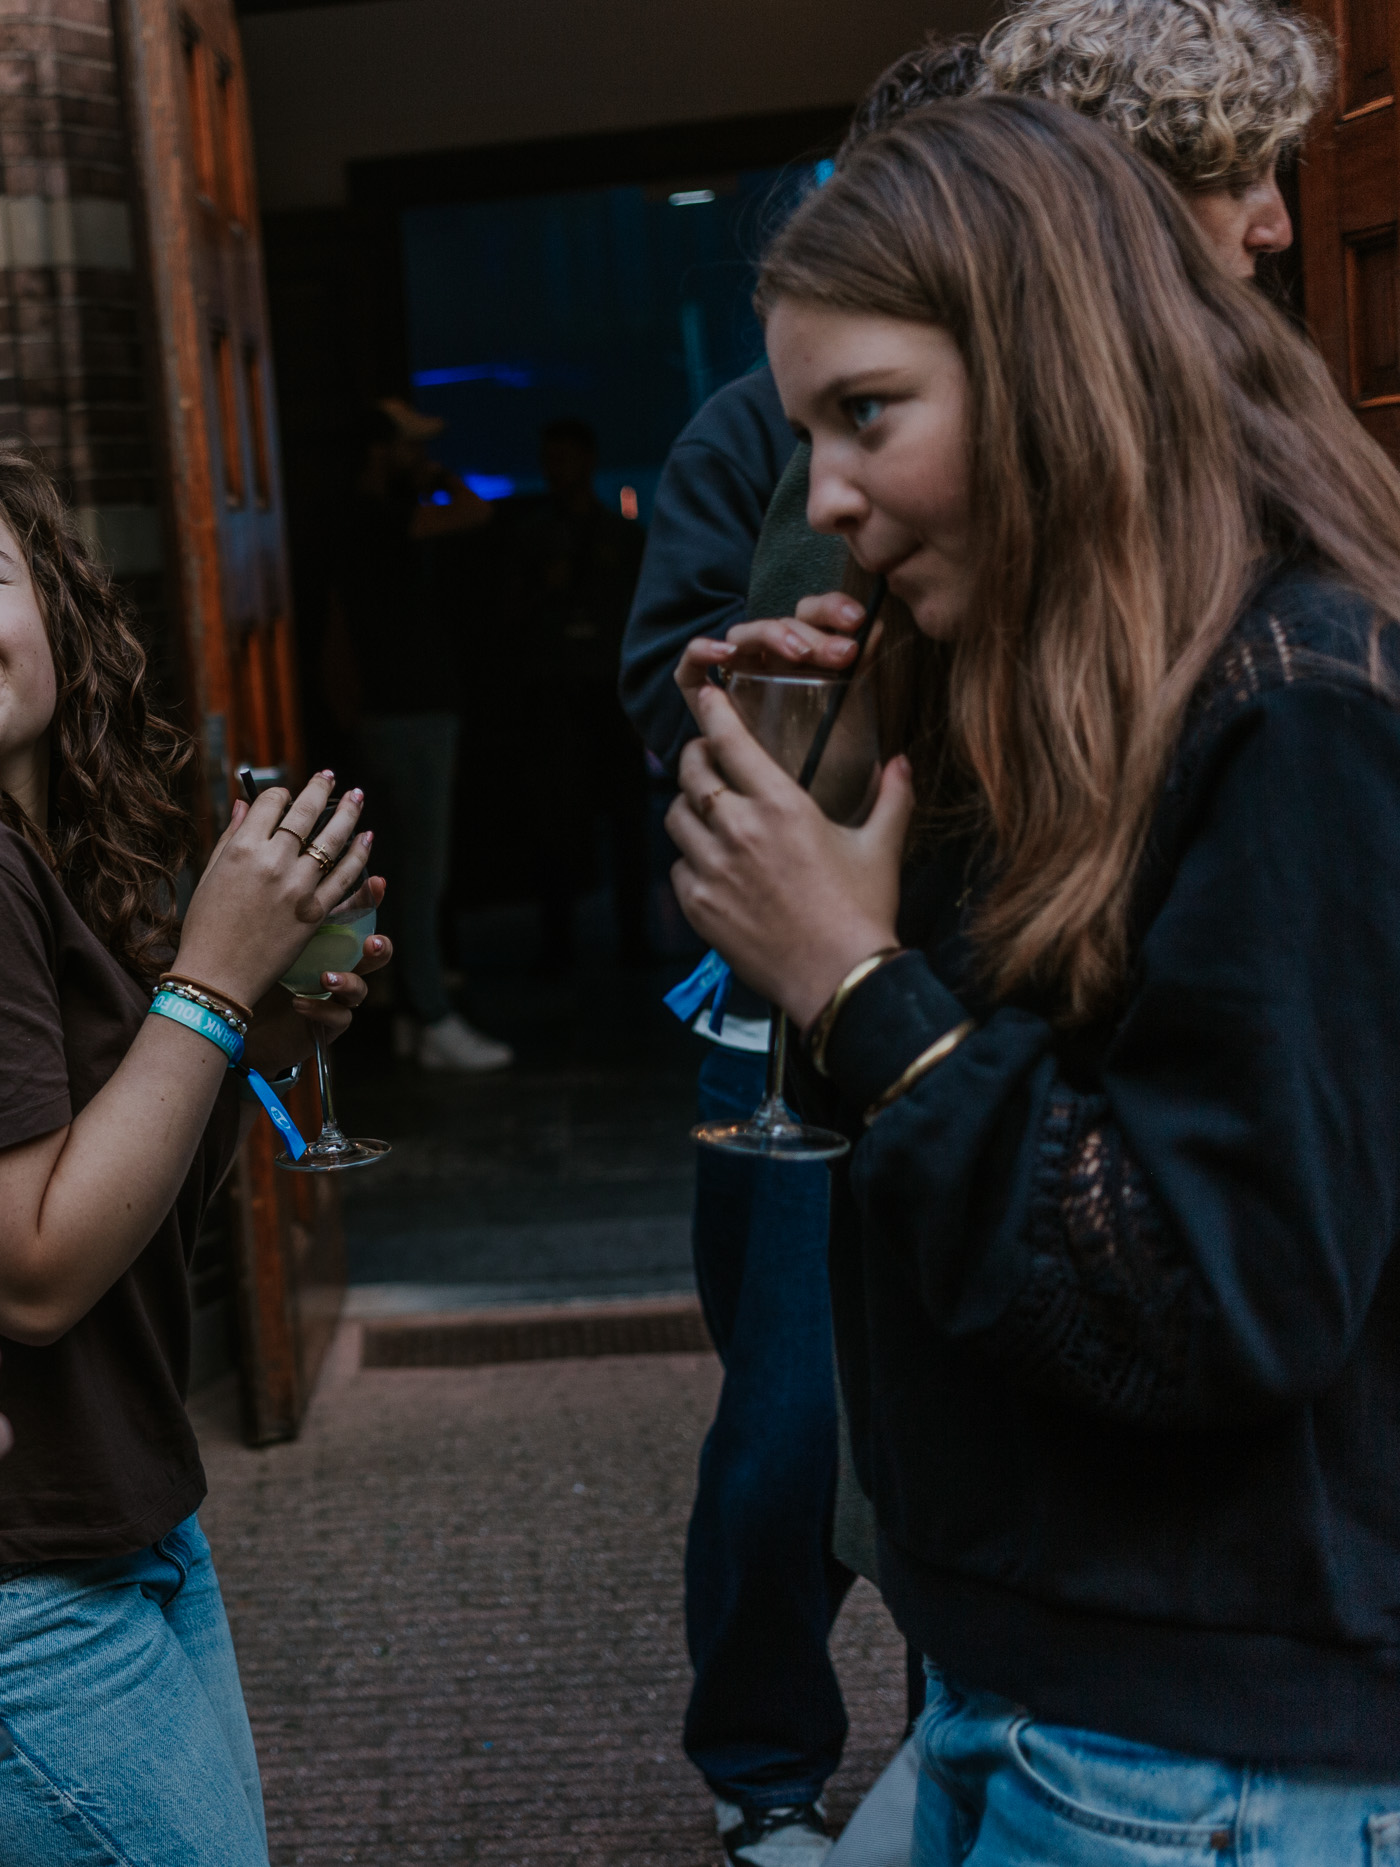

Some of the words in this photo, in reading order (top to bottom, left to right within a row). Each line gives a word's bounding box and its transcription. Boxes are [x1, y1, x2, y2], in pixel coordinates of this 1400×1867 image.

[151, 995, 173, 1010] FO
[171, 1002, 203, 1026] YOU
[203, 1017, 239, 1053] THANK
